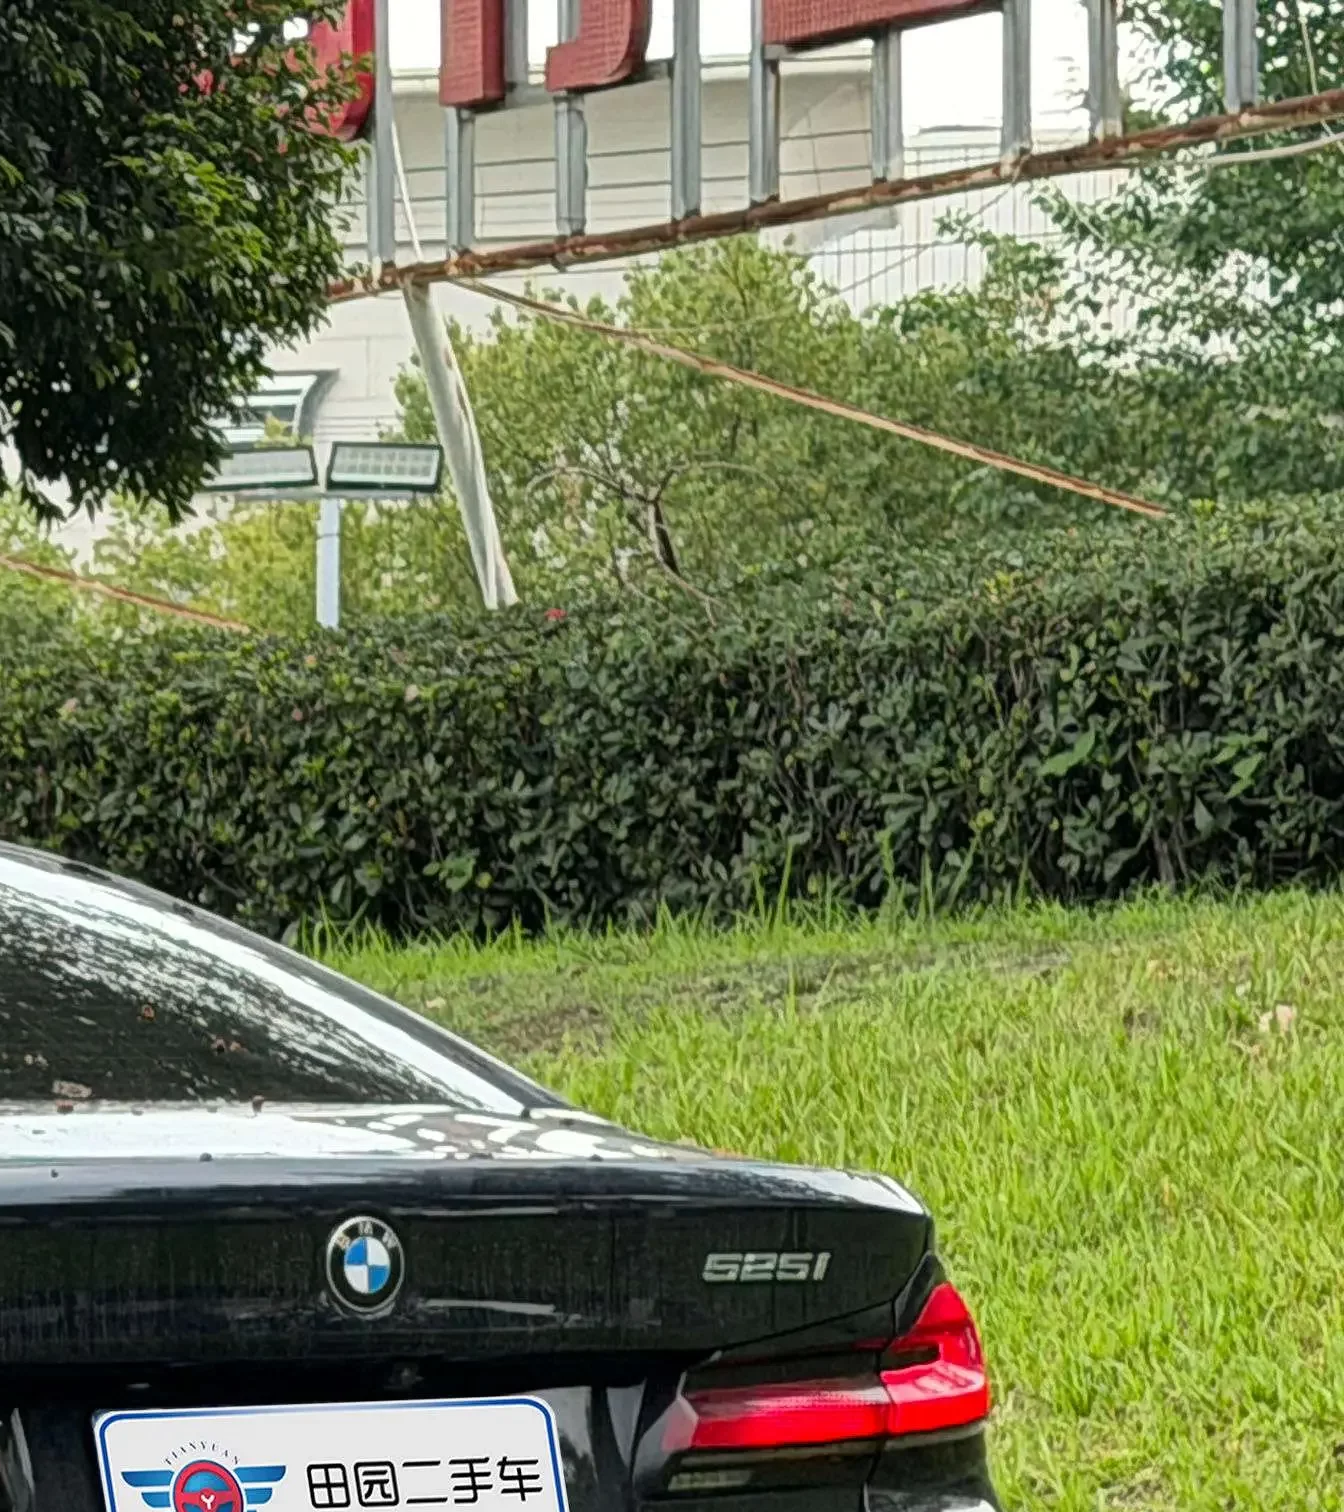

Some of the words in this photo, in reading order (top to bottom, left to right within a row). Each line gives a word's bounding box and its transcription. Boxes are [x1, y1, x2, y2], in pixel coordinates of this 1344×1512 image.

[306, 1456, 543, 1508] 田园二手车
